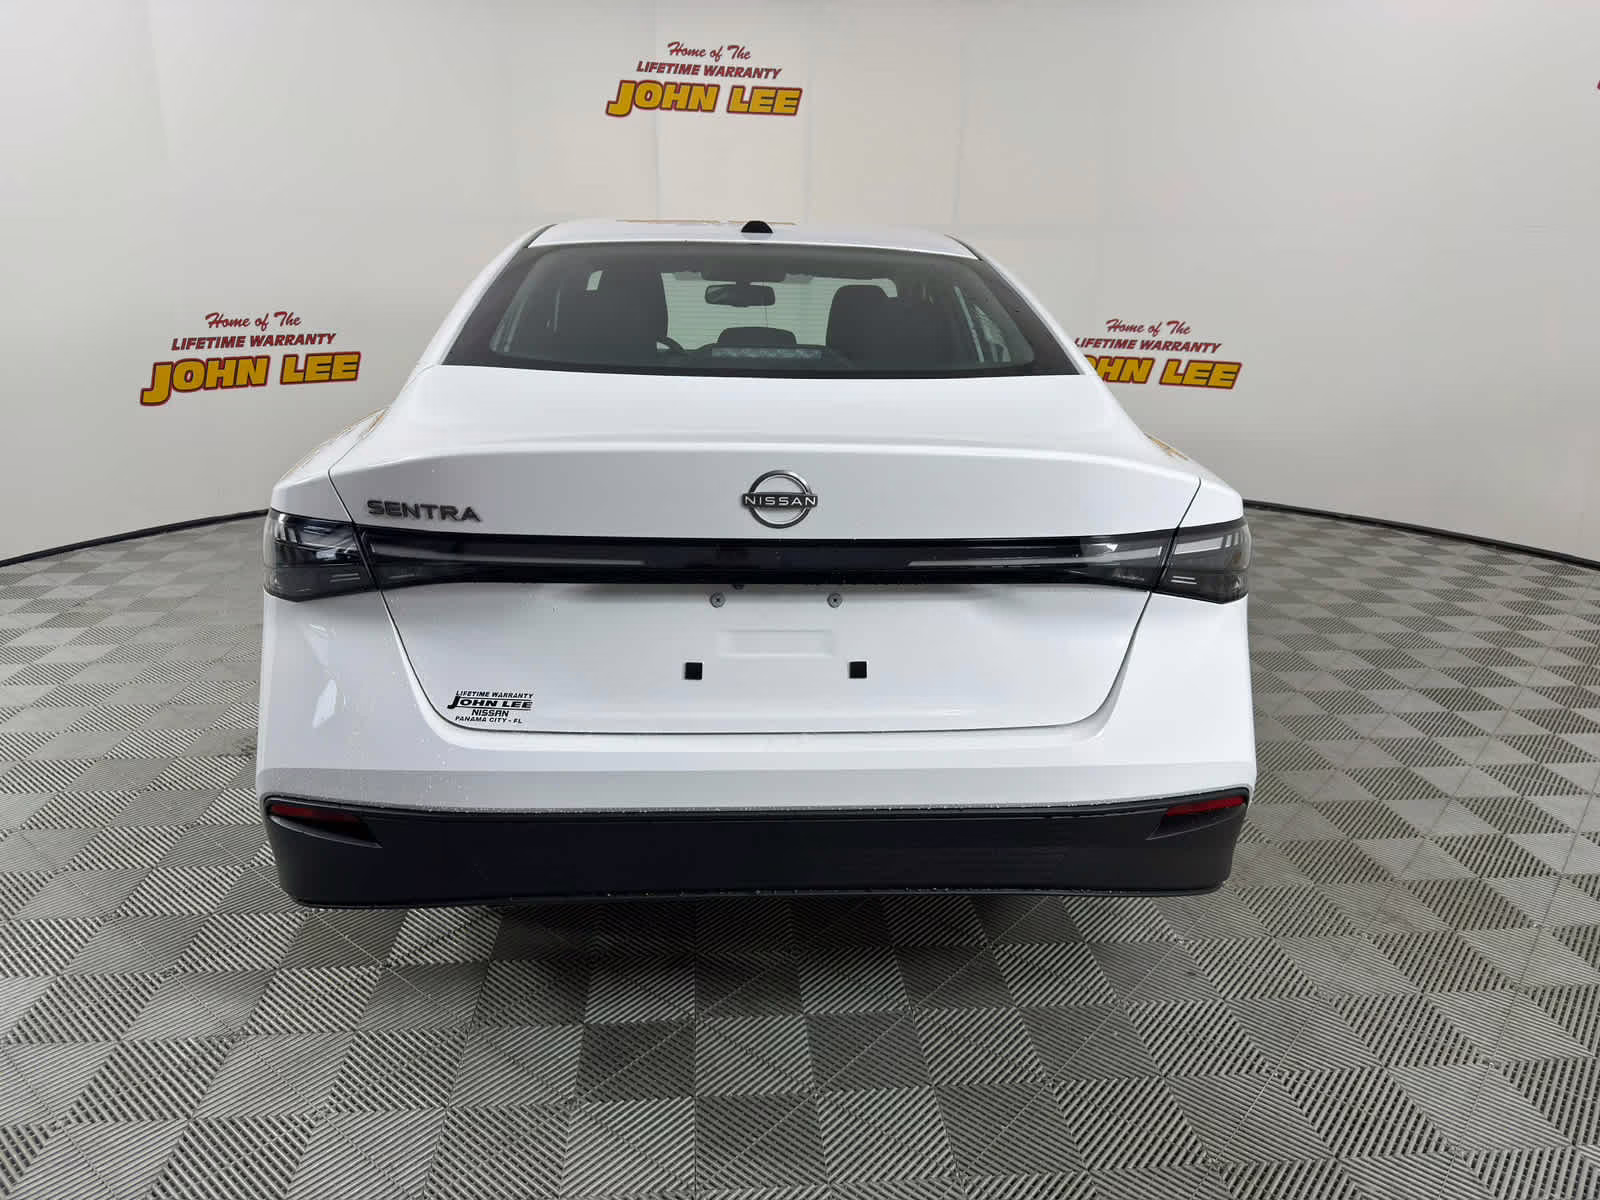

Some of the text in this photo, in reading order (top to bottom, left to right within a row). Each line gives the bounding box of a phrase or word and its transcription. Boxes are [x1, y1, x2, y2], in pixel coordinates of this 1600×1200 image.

[667, 41, 752, 62] Home of The
[636, 61, 782, 80] LIFETIME WARRANTY
[605, 80, 803, 118] JOHN LEE
[205, 311, 301, 331] Home of The
[1105, 318, 1191, 337] Home of The
[171, 333, 336, 351] LIFETIME WARRANTY
[1074, 337, 1222, 354] LIFETIME WARRANTY
[140, 351, 361, 407] JOHN LEE
[1159, 358, 1242, 390] LEE
[745, 495, 816, 506] NISSAN
[367, 500, 482, 522] SENTRA
[447, 695, 533, 709] JOHN LEE
[456, 690, 534, 699] LIFETIME WARRANTY
[471, 709, 509, 717] NISSAN
